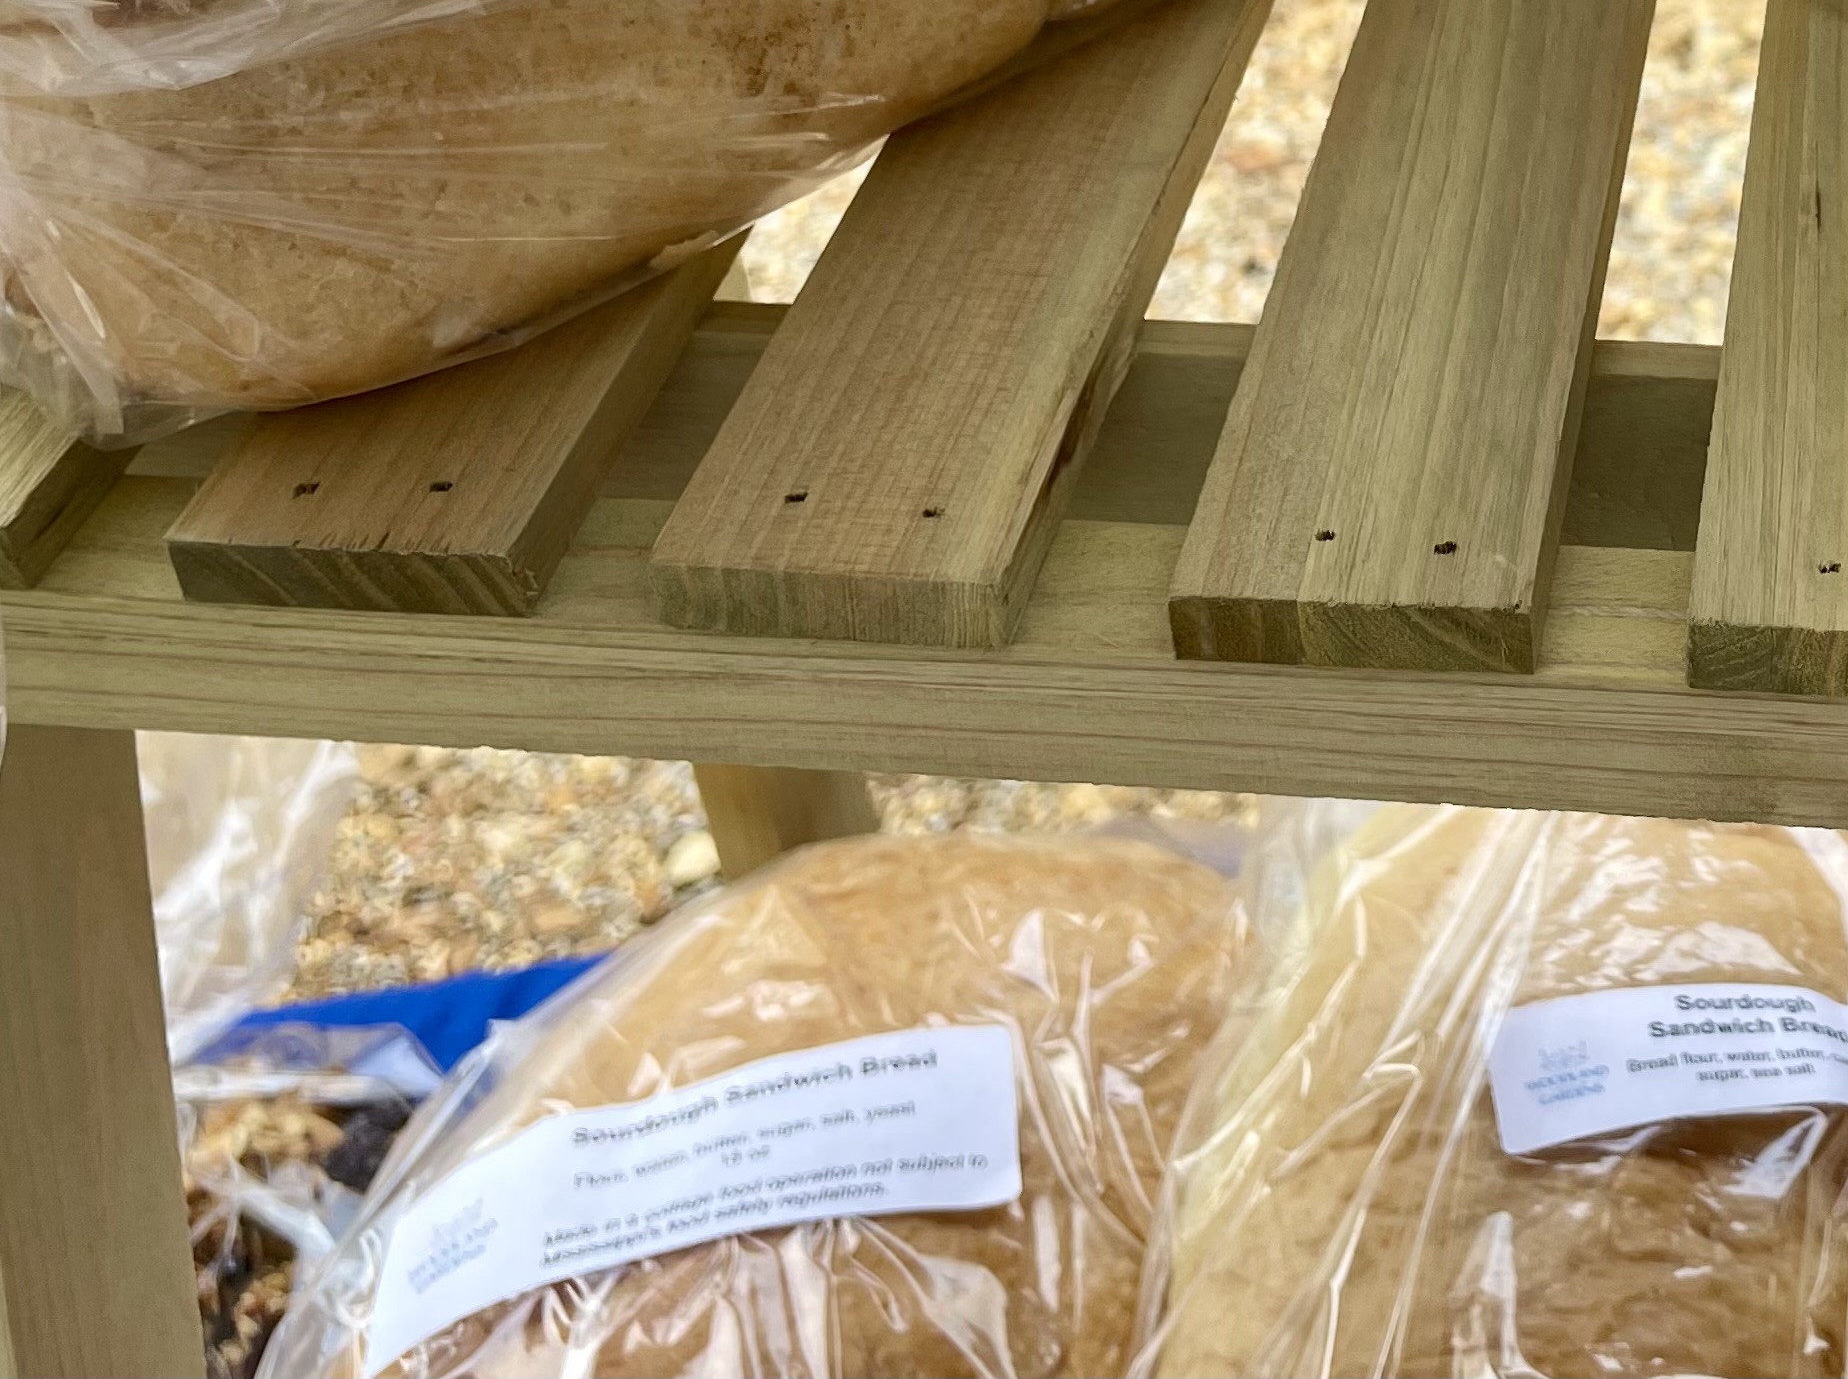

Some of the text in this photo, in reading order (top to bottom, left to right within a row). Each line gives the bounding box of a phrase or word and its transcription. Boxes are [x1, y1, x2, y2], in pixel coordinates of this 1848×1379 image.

[1674, 994, 1816, 1014] Sourdough
[1649, 1017, 1775, 1038] Sandwich
[573, 1050, 938, 1144] Sourdough Sandwich Bread
